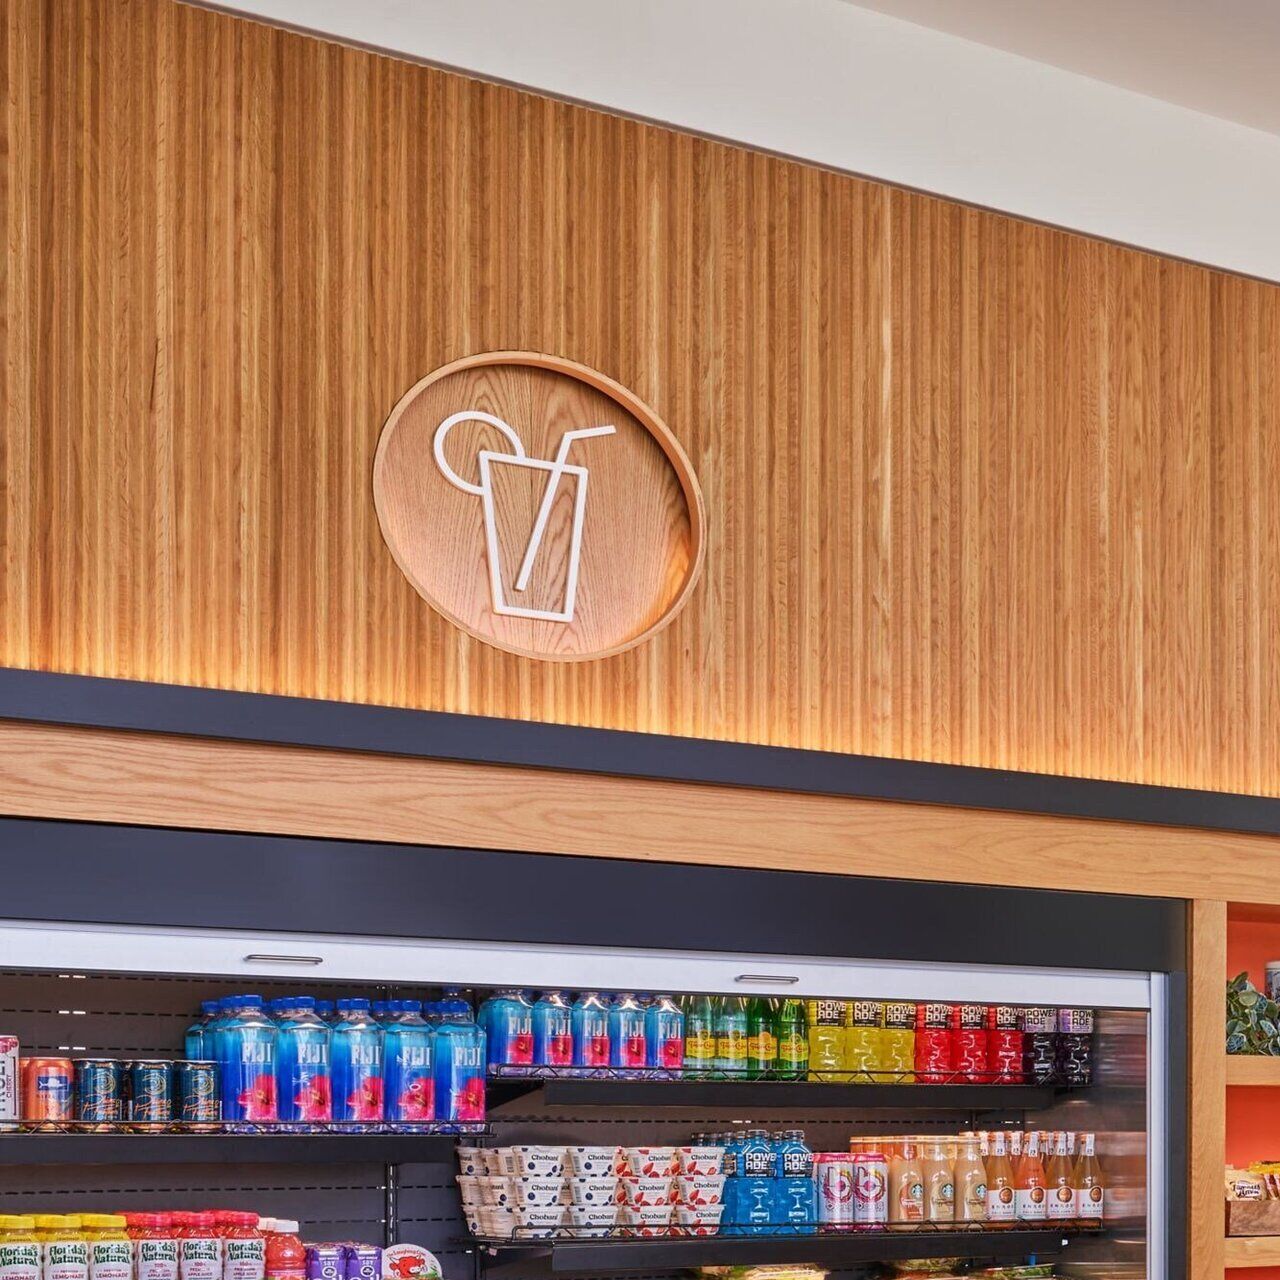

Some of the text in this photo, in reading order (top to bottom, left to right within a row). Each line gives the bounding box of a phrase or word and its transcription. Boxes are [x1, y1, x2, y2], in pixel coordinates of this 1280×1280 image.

[508, 1015, 532, 1034] FIJI
[661, 1020, 681, 1038] FIJI
[242, 1042, 272, 1063] FIJI
[297, 1043, 327, 1065] FIJI
[350, 1045, 381, 1066] FIJI
[402, 1046, 431, 1066] FIJI
[454, 1047, 481, 1066] FIJI
